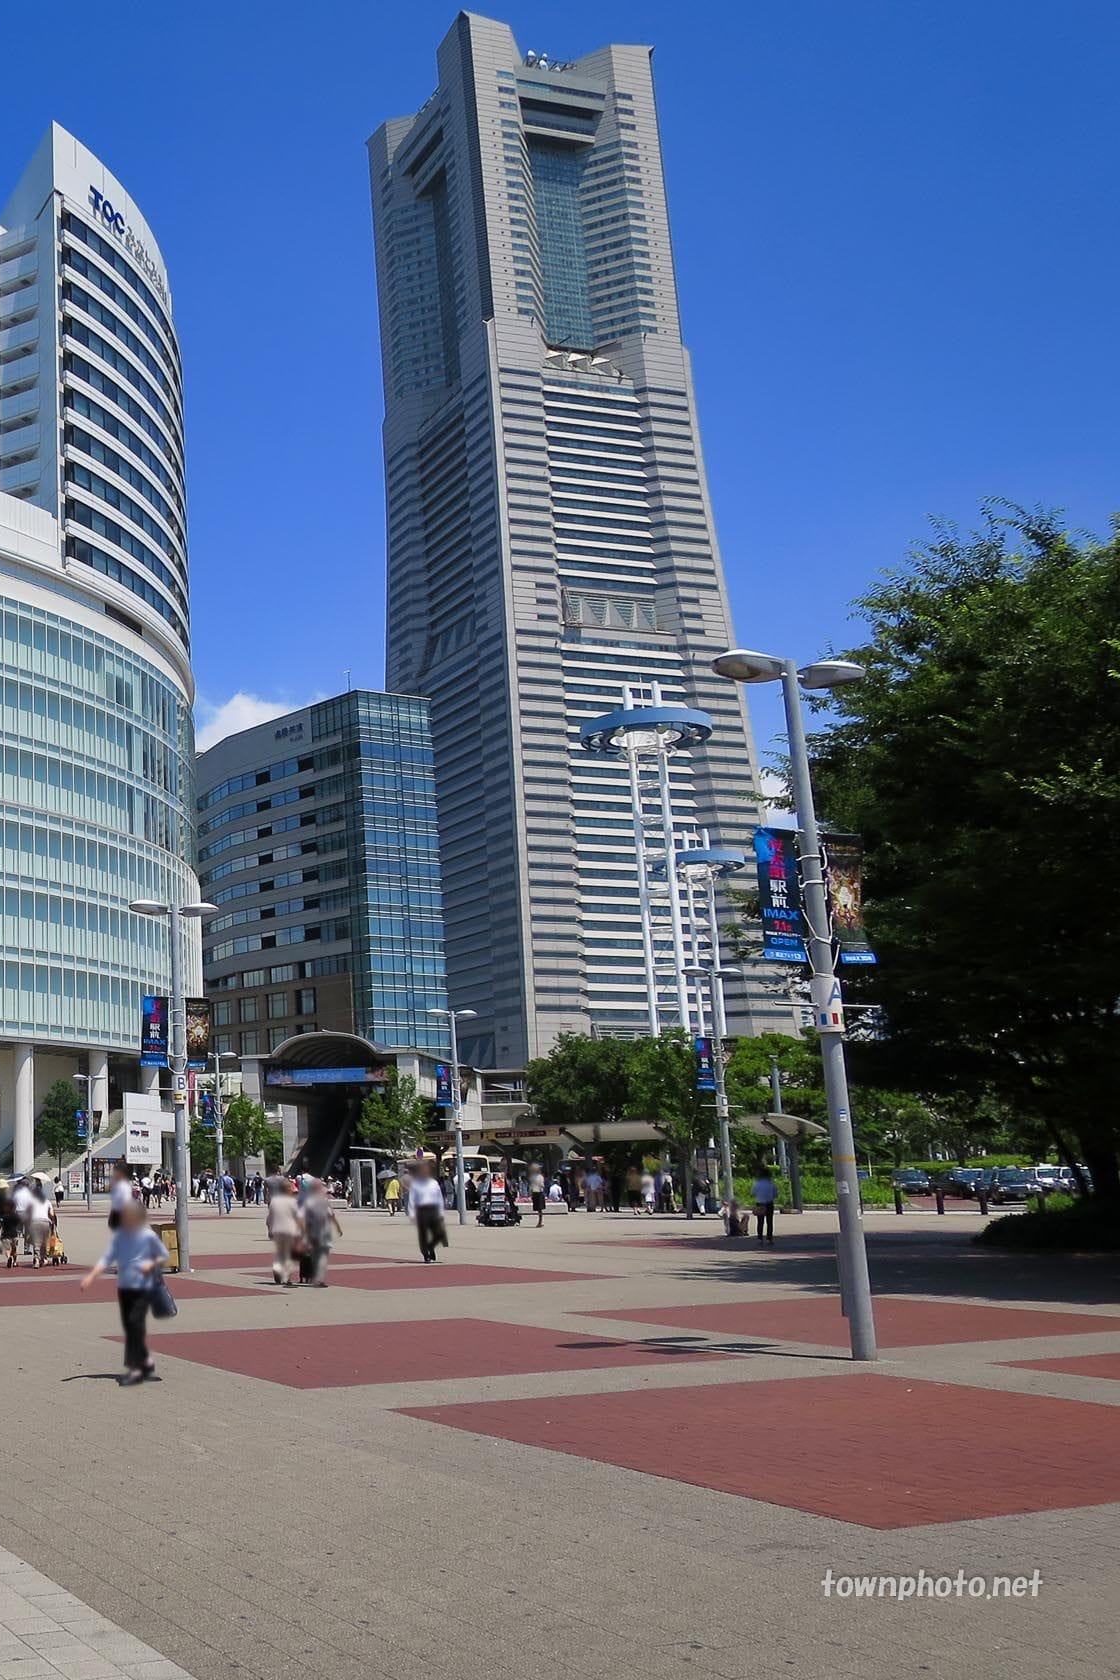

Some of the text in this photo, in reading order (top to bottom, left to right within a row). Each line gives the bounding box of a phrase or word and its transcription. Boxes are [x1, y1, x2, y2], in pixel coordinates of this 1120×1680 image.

[89, 184, 125, 235] TOC
[764, 908, 799, 920] IMAX
[771, 937, 798, 946] OPEN
[828, 981, 841, 1006] A
[178, 1077, 186, 1090] B
